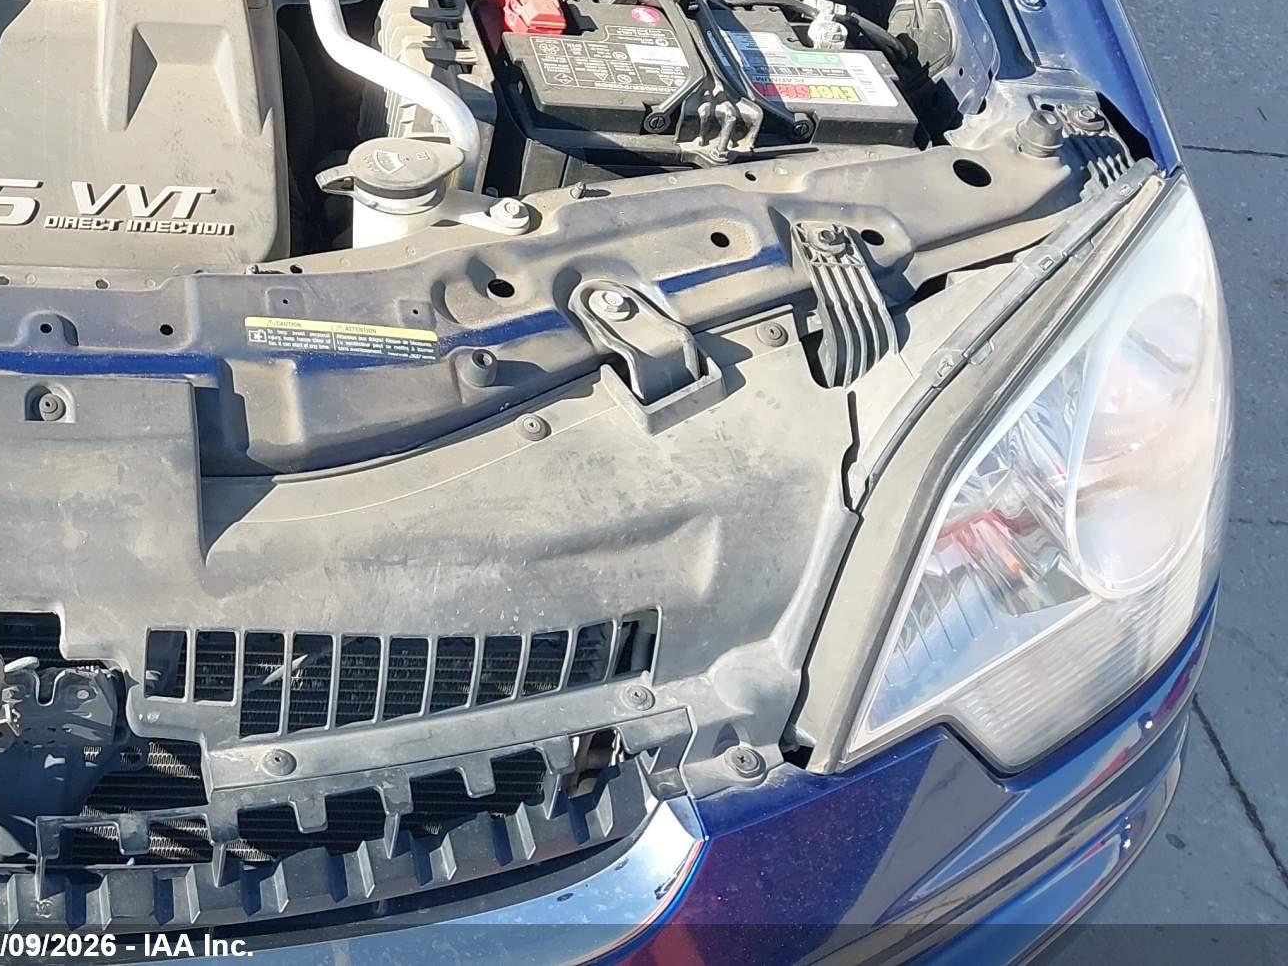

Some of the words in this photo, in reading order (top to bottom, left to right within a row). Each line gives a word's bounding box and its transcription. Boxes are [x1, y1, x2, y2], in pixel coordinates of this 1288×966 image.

[72, 181, 217, 219] VVT
[43, 216, 124, 232] DIRECT
[127, 219, 235, 236] INJECTION
[344, 326, 377, 334] ATTENTION
